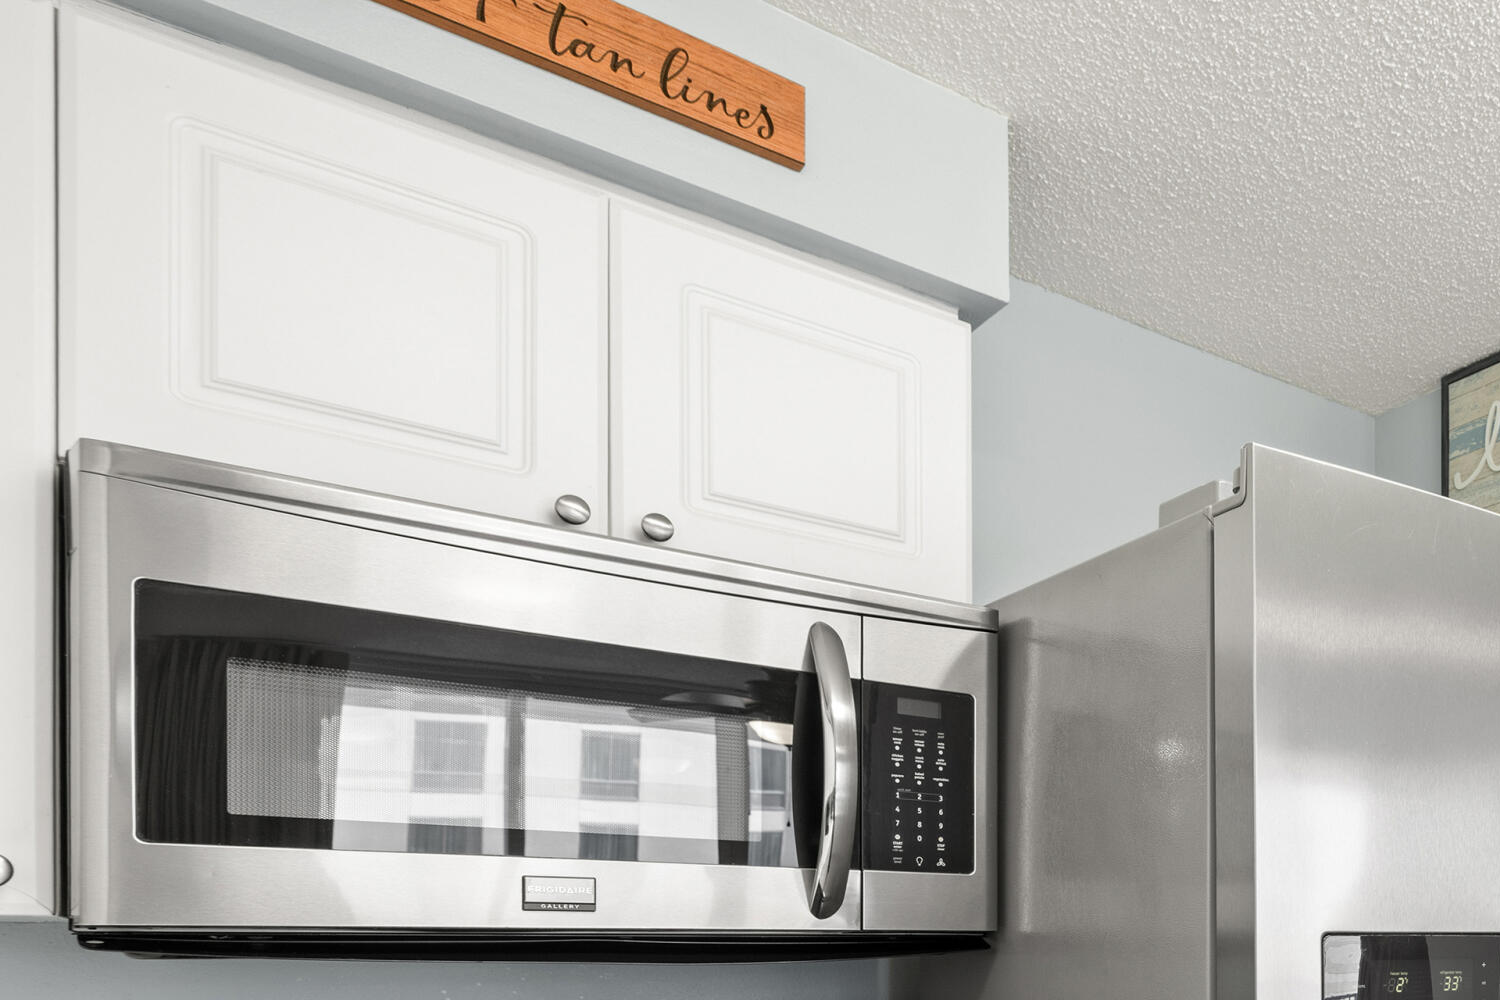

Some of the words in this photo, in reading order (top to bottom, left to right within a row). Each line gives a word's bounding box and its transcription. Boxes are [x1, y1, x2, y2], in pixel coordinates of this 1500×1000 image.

[533, 2, 645, 79] tan
[658, 47, 776, 140] lines
[527, 885, 593, 895] FRIGIDAIRE
